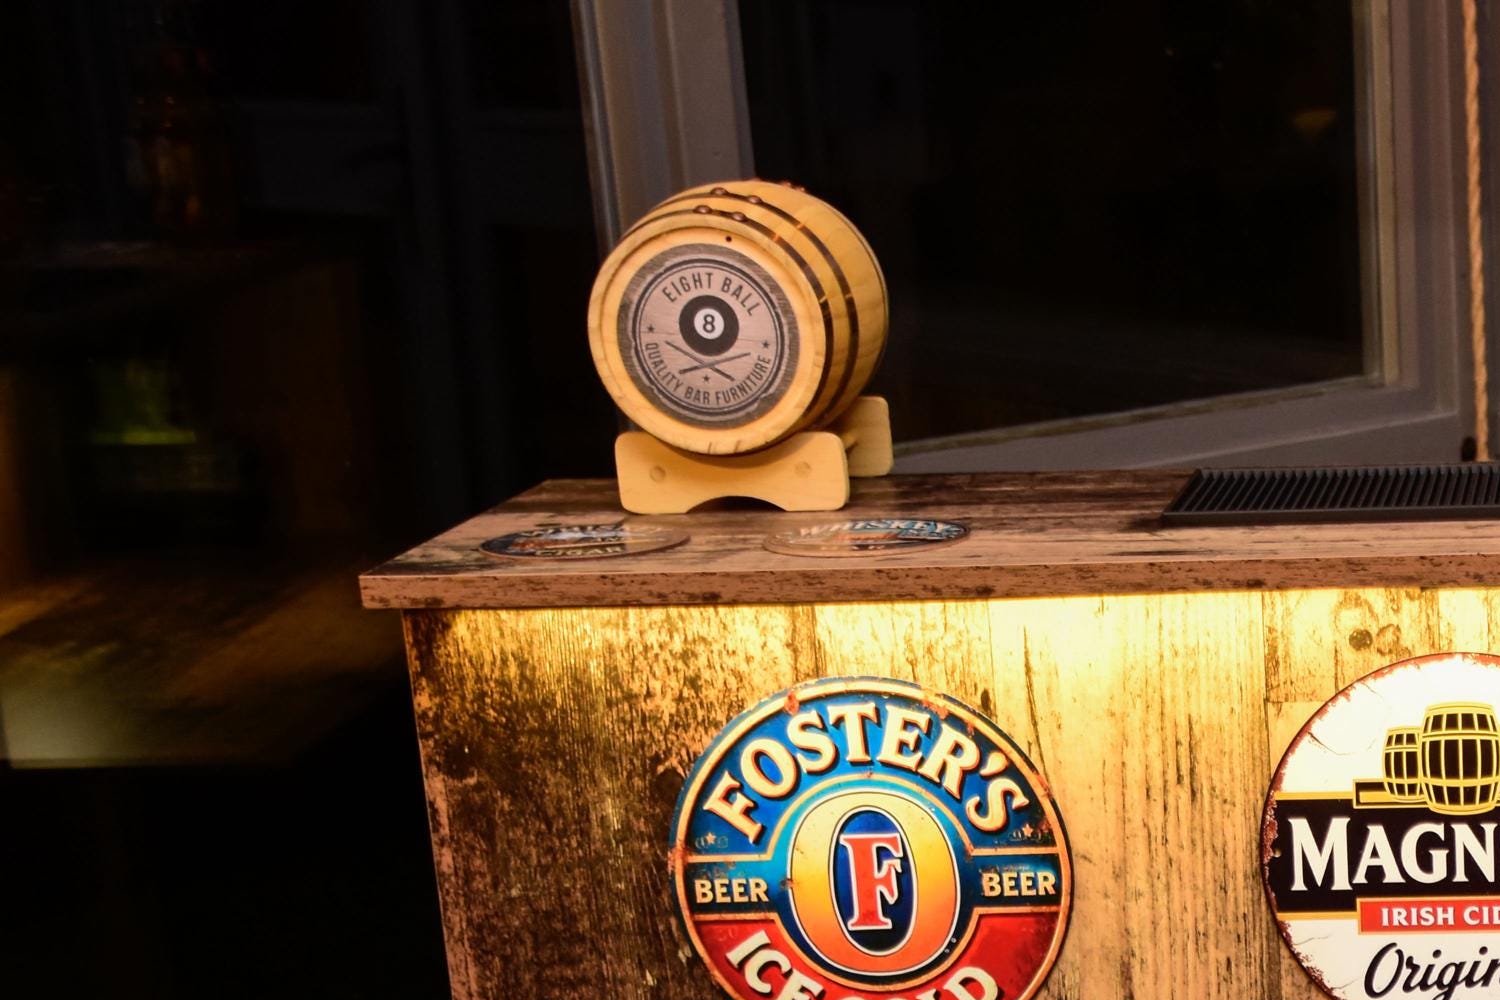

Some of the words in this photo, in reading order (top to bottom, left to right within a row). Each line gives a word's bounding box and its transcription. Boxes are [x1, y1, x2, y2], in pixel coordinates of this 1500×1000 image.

[661, 272, 714, 303] EIGHT
[720, 281, 762, 316] BALL
[702, 313, 716, 334] 8
[645, 342, 685, 392] QUALITY
[684, 386, 710, 405] BAR
[715, 354, 771, 406] FURNITURE
[703, 700, 1030, 845] FOSTER'S
[694, 877, 769, 904] BEER
[838, 832, 904, 932] F
[981, 870, 1057, 897] BEER
[1381, 906, 1455, 927] IRISH
